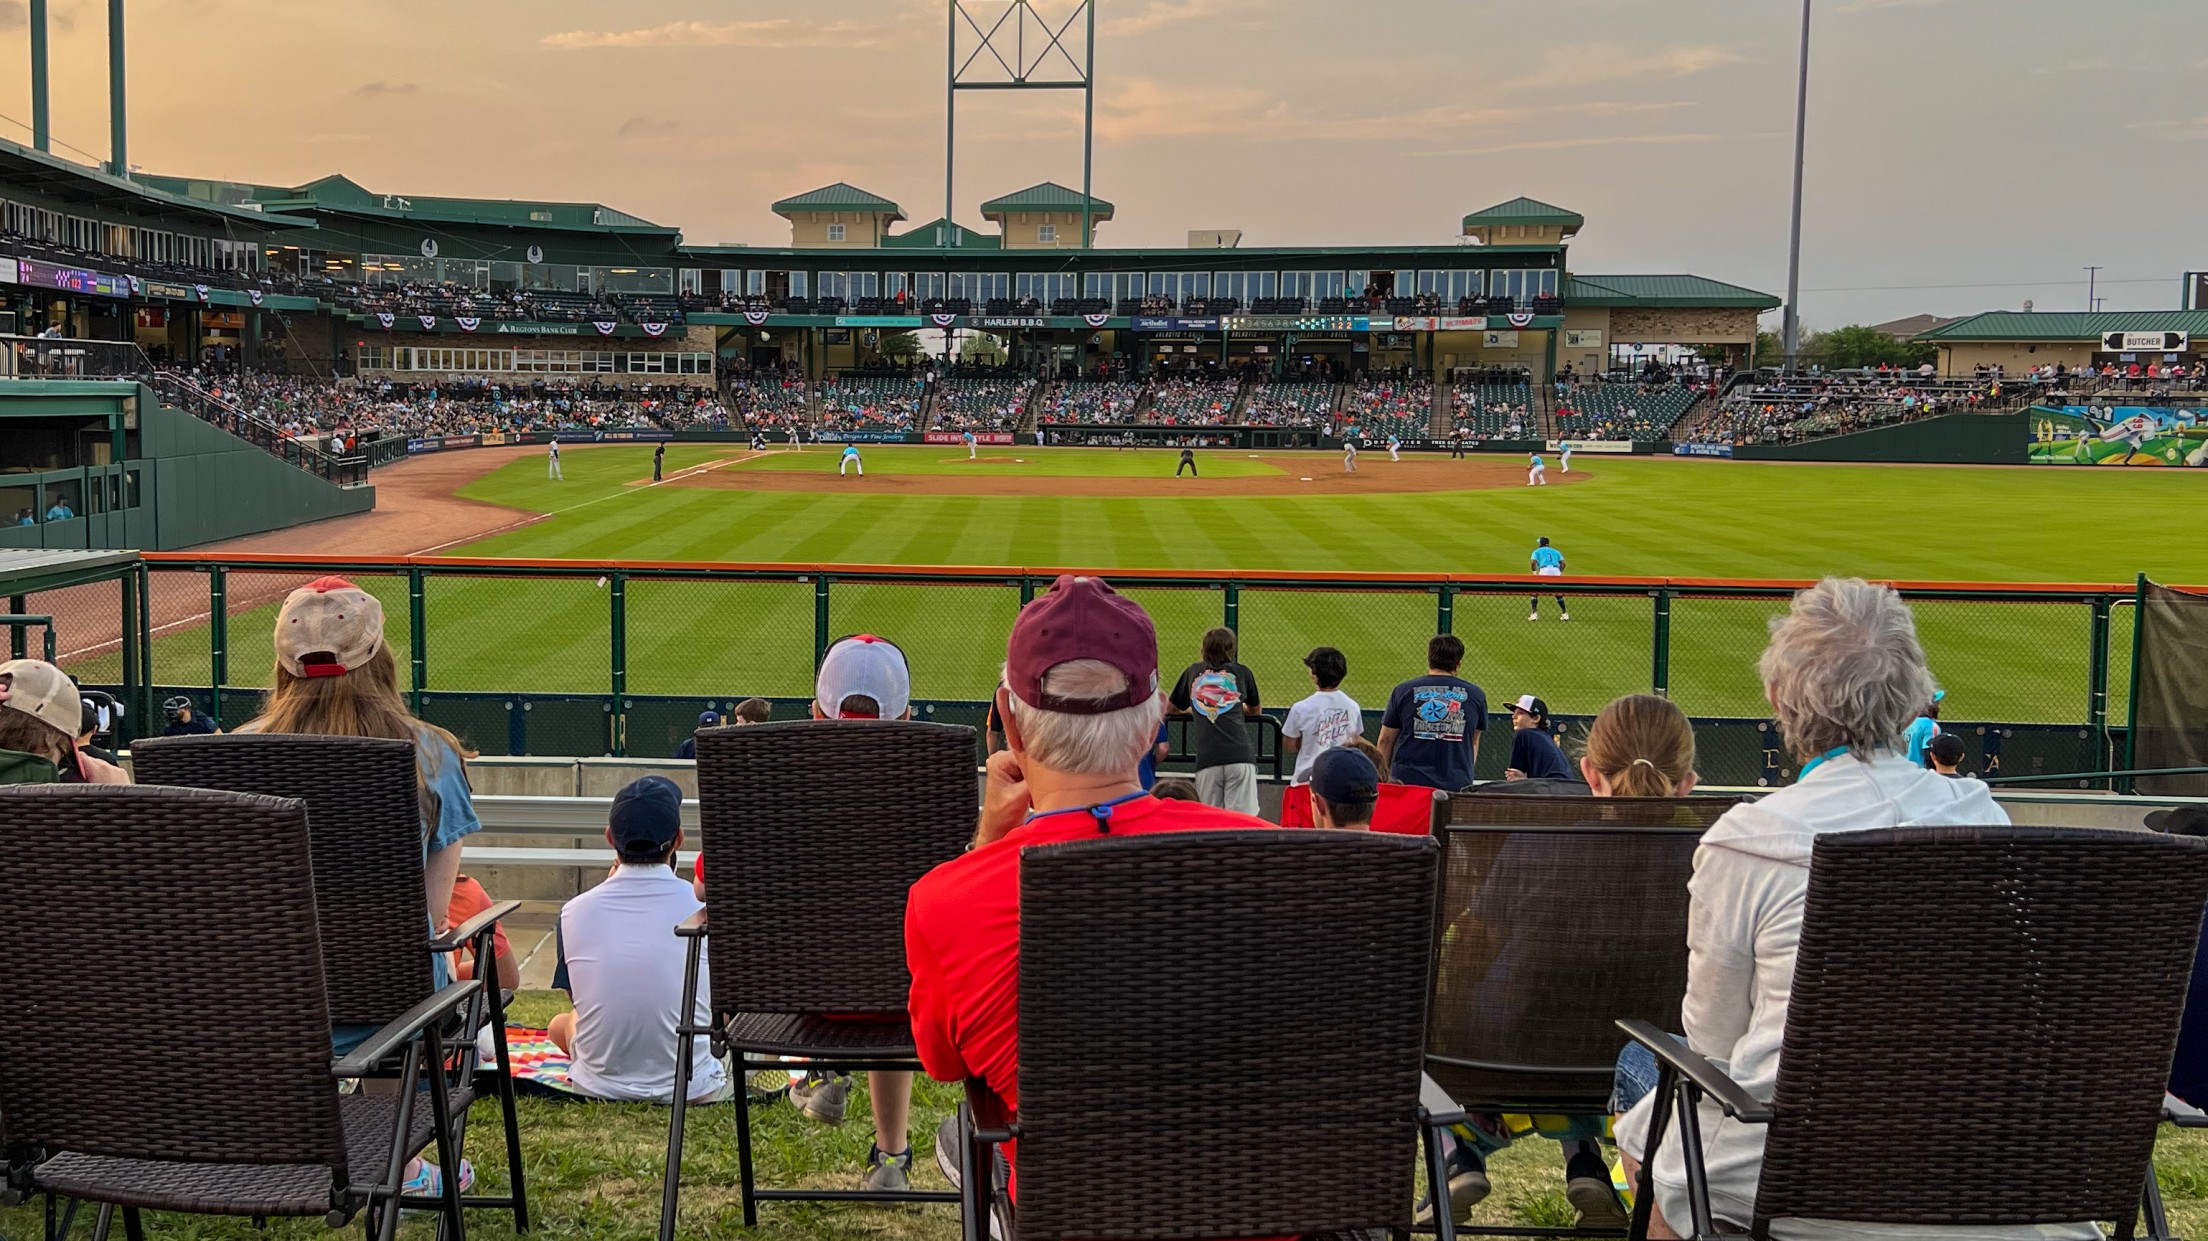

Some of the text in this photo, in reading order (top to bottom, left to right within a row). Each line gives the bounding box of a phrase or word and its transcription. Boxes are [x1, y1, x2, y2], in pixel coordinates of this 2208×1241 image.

[426, 239, 433, 250] 4
[532, 245, 538, 256] 8
[984, 318, 1045, 326] HARLEM B.B.Q.
[510, 325, 540, 333] REGIONS
[560, 326, 577, 334] CLUB
[2126, 337, 2160, 346] BUTCHER
[1316, 723, 1349, 746] CRUZ
